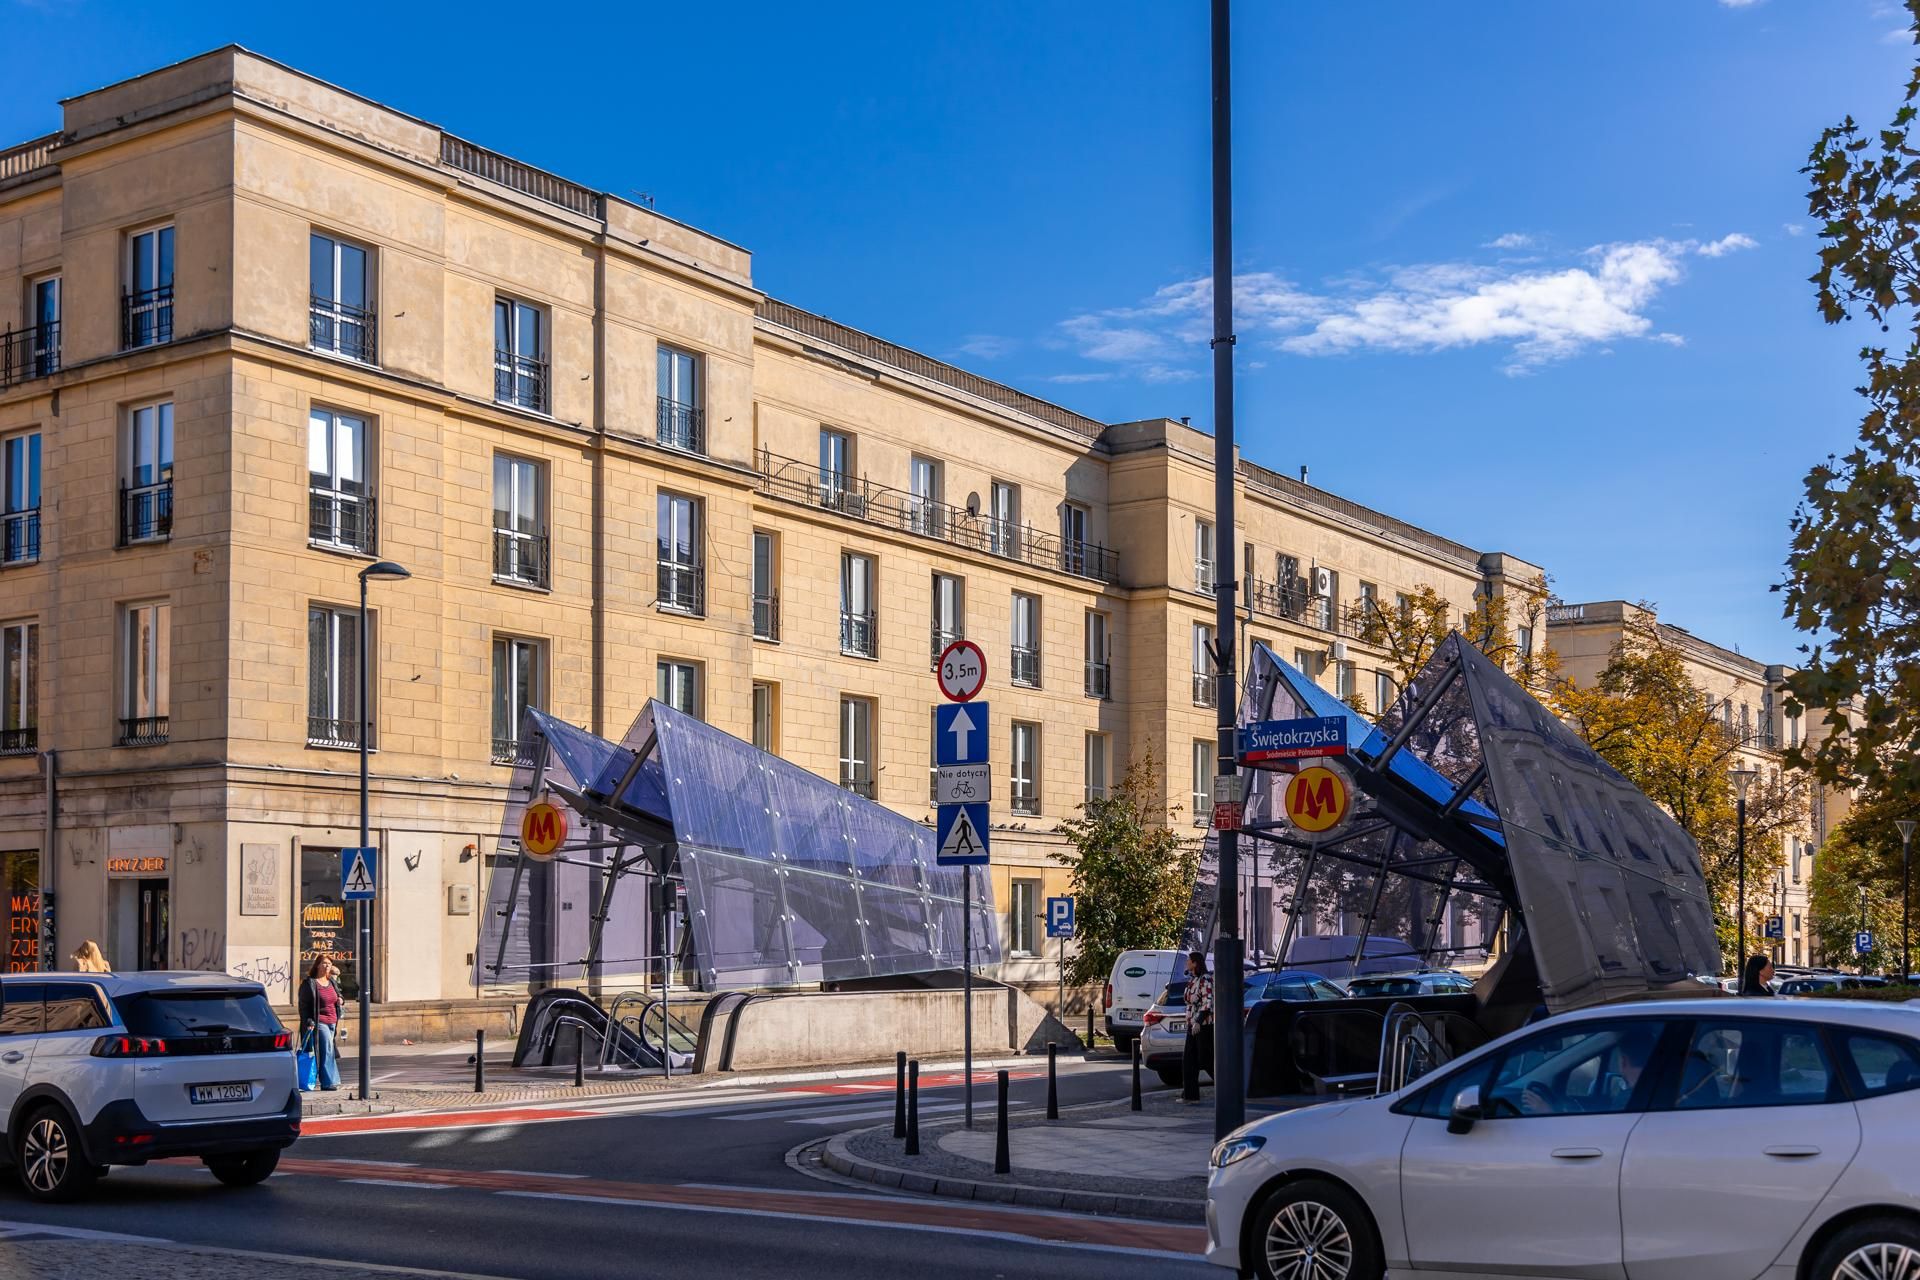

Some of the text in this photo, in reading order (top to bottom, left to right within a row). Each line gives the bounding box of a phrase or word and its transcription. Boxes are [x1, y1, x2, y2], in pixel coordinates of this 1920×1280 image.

[944, 663, 978, 680] 3,5m
[1251, 726, 1339, 749] Świętokrzyska
[939, 769, 988, 779] Nie dotyczy
[107, 857, 165, 872] FRYZJER
[1053, 901, 1069, 926] P
[11, 917, 39, 934] FRY
[1768, 918, 1780, 932] P
[11, 939, 39, 957] ZJE
[1860, 934, 1869, 947] P
[198, 1085, 250, 1100] WW 120SM
